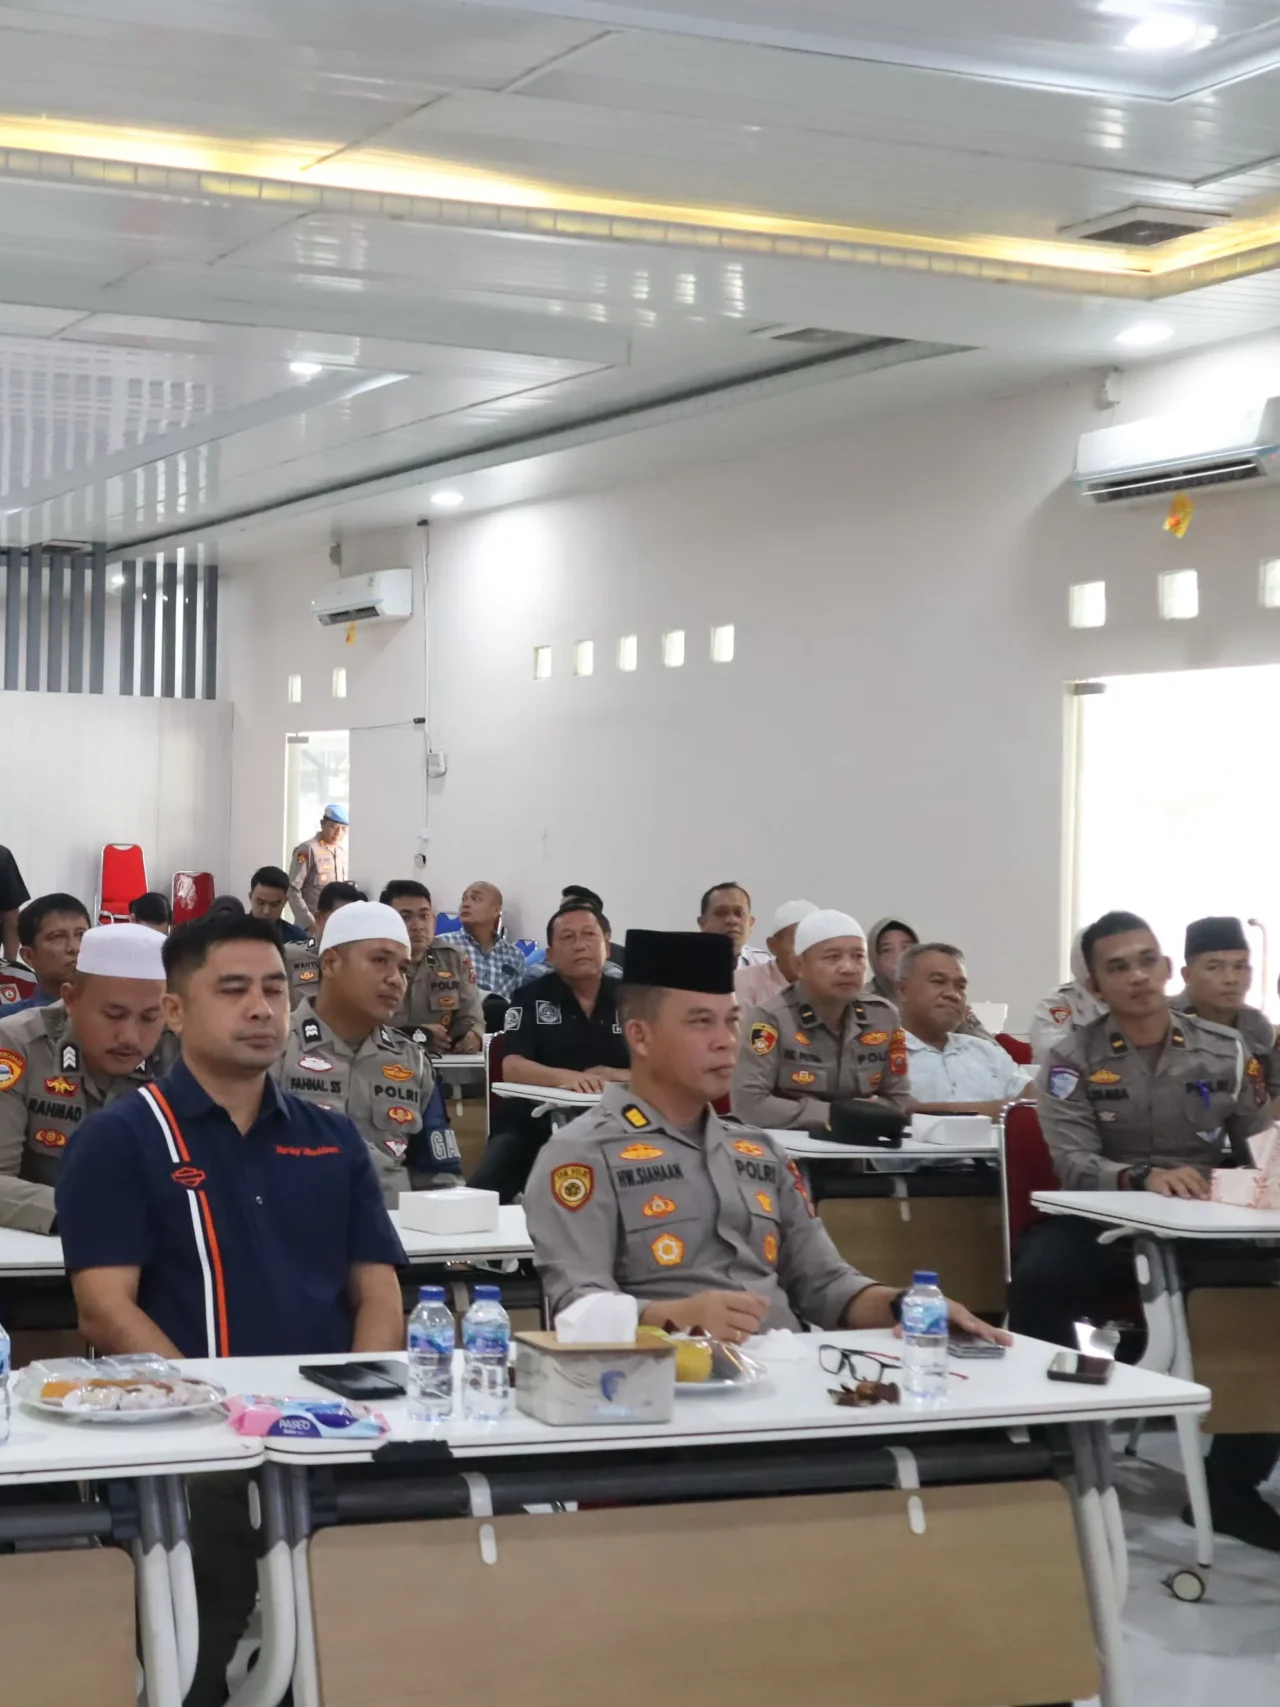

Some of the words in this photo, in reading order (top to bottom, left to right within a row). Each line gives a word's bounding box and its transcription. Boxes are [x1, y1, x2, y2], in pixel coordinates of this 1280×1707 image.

[374, 1084, 418, 1103] POLRI
[29, 1099, 82, 1122] RAHMAD
[735, 1160, 776, 1185] POLRI
[279, 1419, 311, 1431] PASEO
